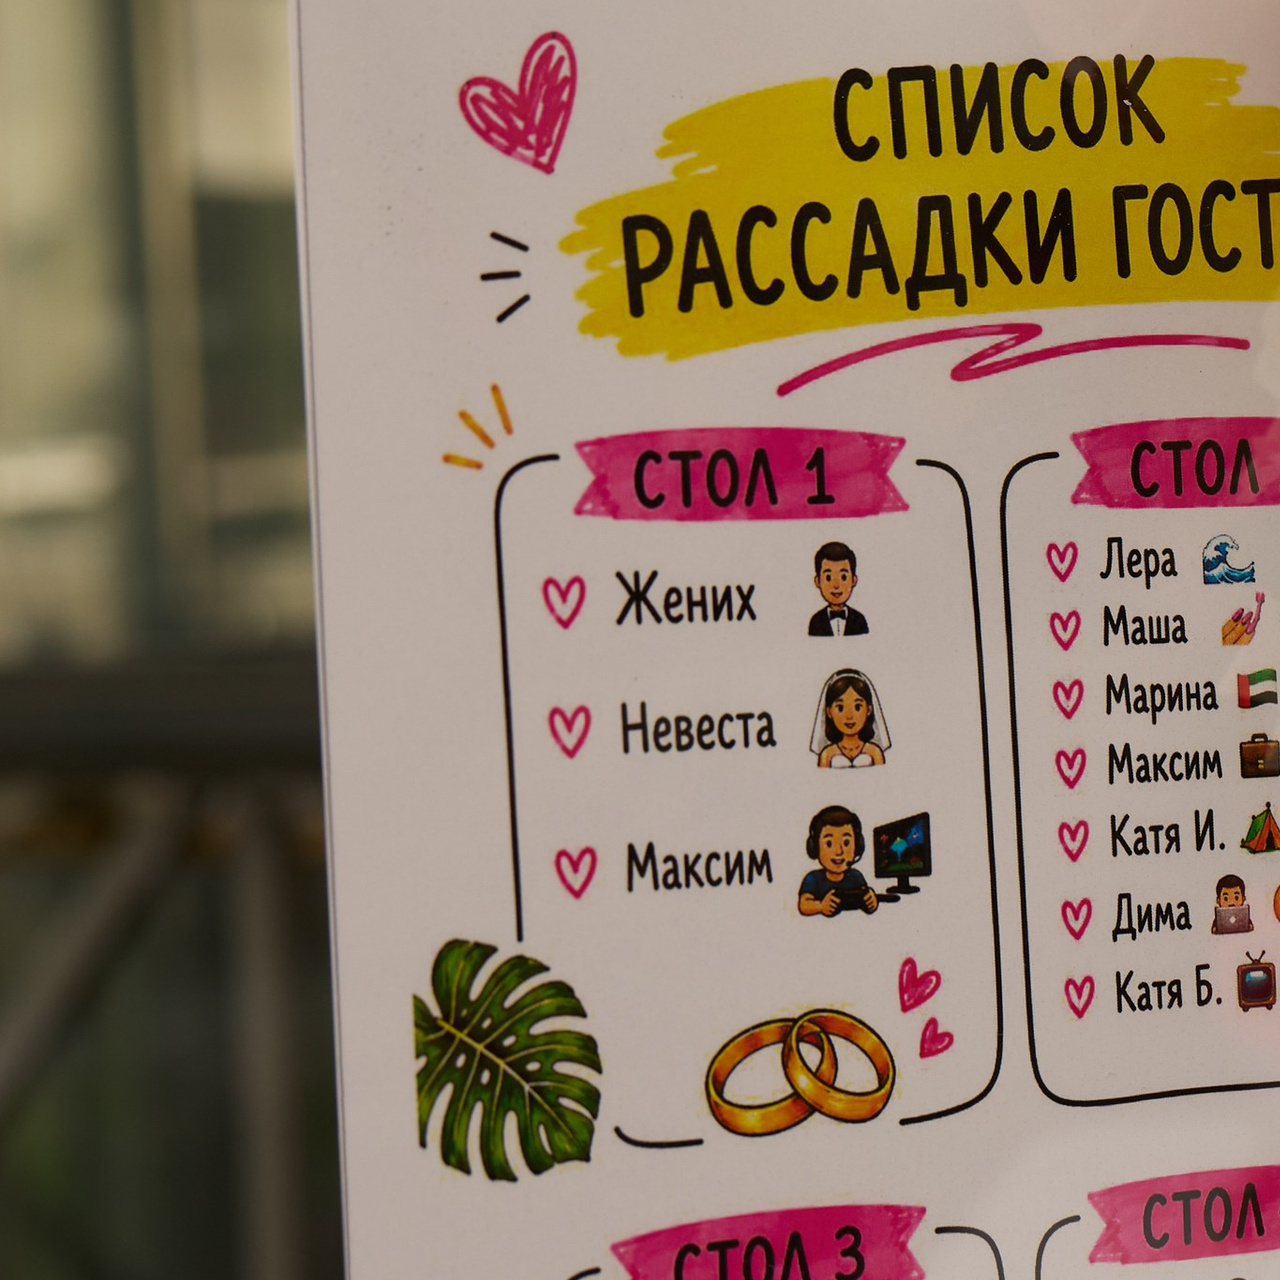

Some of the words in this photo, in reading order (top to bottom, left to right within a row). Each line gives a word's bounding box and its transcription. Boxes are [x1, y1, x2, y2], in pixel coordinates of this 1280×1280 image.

[833, 53, 1166, 163] СПИСОК
[621, 187, 1078, 319] РАССАДКИ
[633, 447, 779, 510] СТОЛ
[805, 447, 836, 505] 1
[1130, 438, 1260, 498] СТОЛ
[1099, 536, 1179, 590] Лера
[615, 570, 757, 626] Жених
[1102, 603, 1189, 648] Маша
[1105, 673, 1220, 726] Марина
[621, 701, 778, 755] Невеста
[1108, 742, 1223, 786] Максим
[1110, 813, 1181, 858] Катя
[1194, 808, 1226, 852] И.
[627, 841, 774, 893] Максим
[1111, 892, 1193, 943] Дима
[1115, 969, 1183, 1014] Катя
[1195, 963, 1223, 1007] Б.
[1142, 1182, 1265, 1249] СТОЛ
